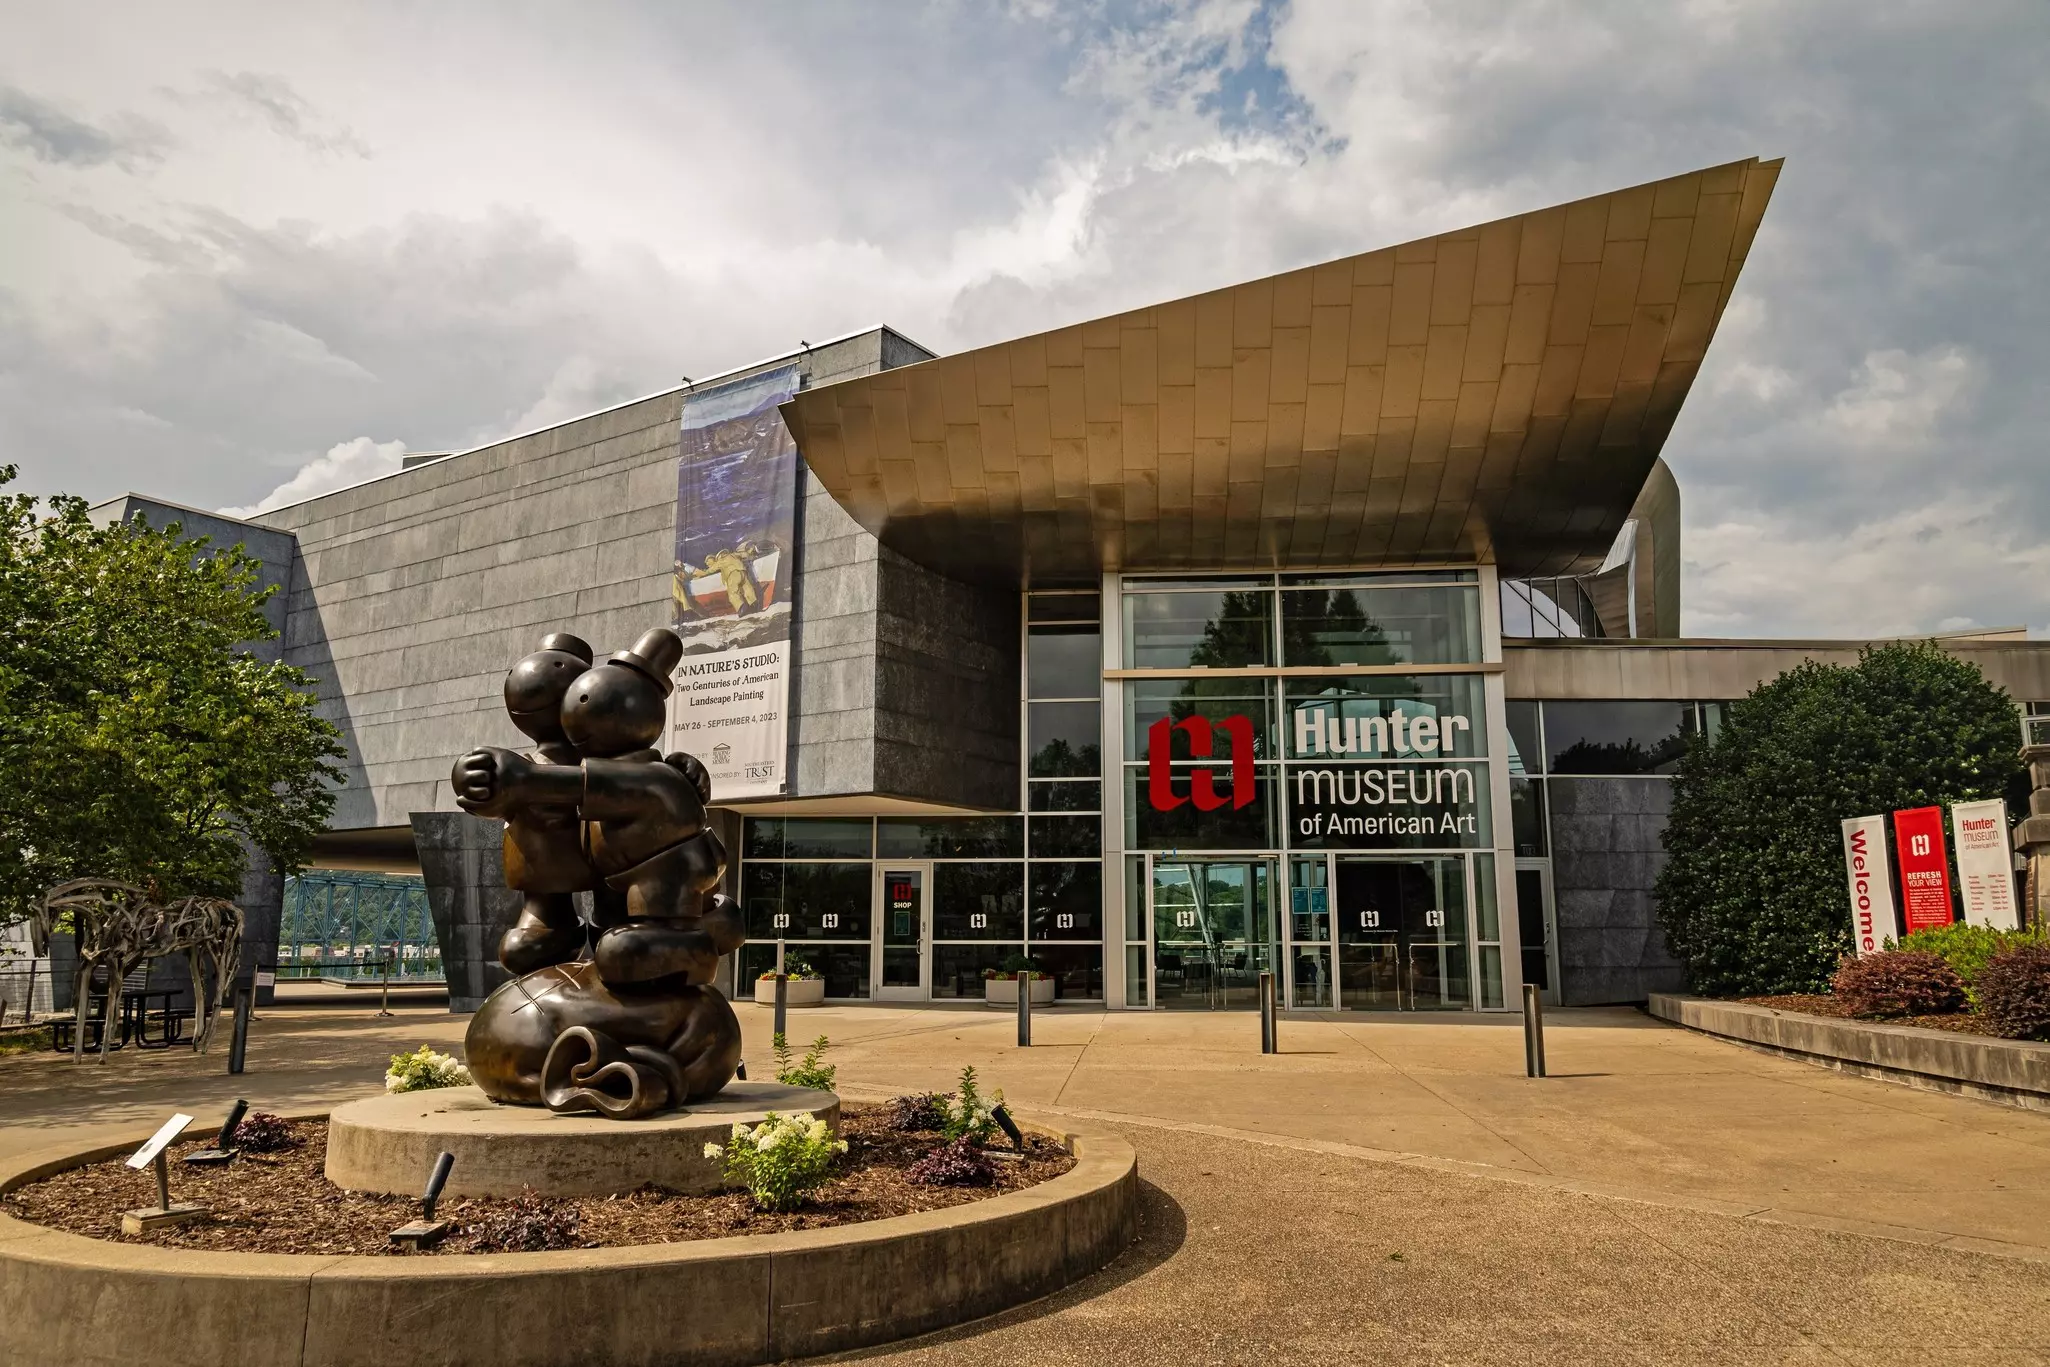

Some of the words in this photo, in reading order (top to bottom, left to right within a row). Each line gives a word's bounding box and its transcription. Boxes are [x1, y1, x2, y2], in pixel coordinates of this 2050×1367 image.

[678, 666, 687, 678] IN
[689, 659, 741, 676] NATURE'S
[742, 652, 780, 669] STUDIO:
[676, 683, 690, 693] Two
[693, 679, 731, 691] Centuries
[732, 677, 740, 686] of
[742, 672, 779, 685] American
[690, 696, 731, 706] Landscape
[733, 690, 764, 702] Painting
[674, 722, 690, 732] MAY
[692, 722, 701, 730] 26
[707, 716, 750, 729] SEPTEMBER
[751, 715, 758, 724] 4,
[759, 712, 778, 722] 2023
[1295, 707, 1470, 753] Hunter
[744, 765, 775, 778] TRUST
[1300, 812, 1323, 835] of
[1327, 812, 1435, 835] American
[1440, 811, 1476, 834] Art
[1962, 817, 1996, 831] Hunter
[1907, 871, 1941, 880] REFRESH
[1908, 879, 1924, 887] YOUR
[1850, 829, 1875, 952] Welcome
